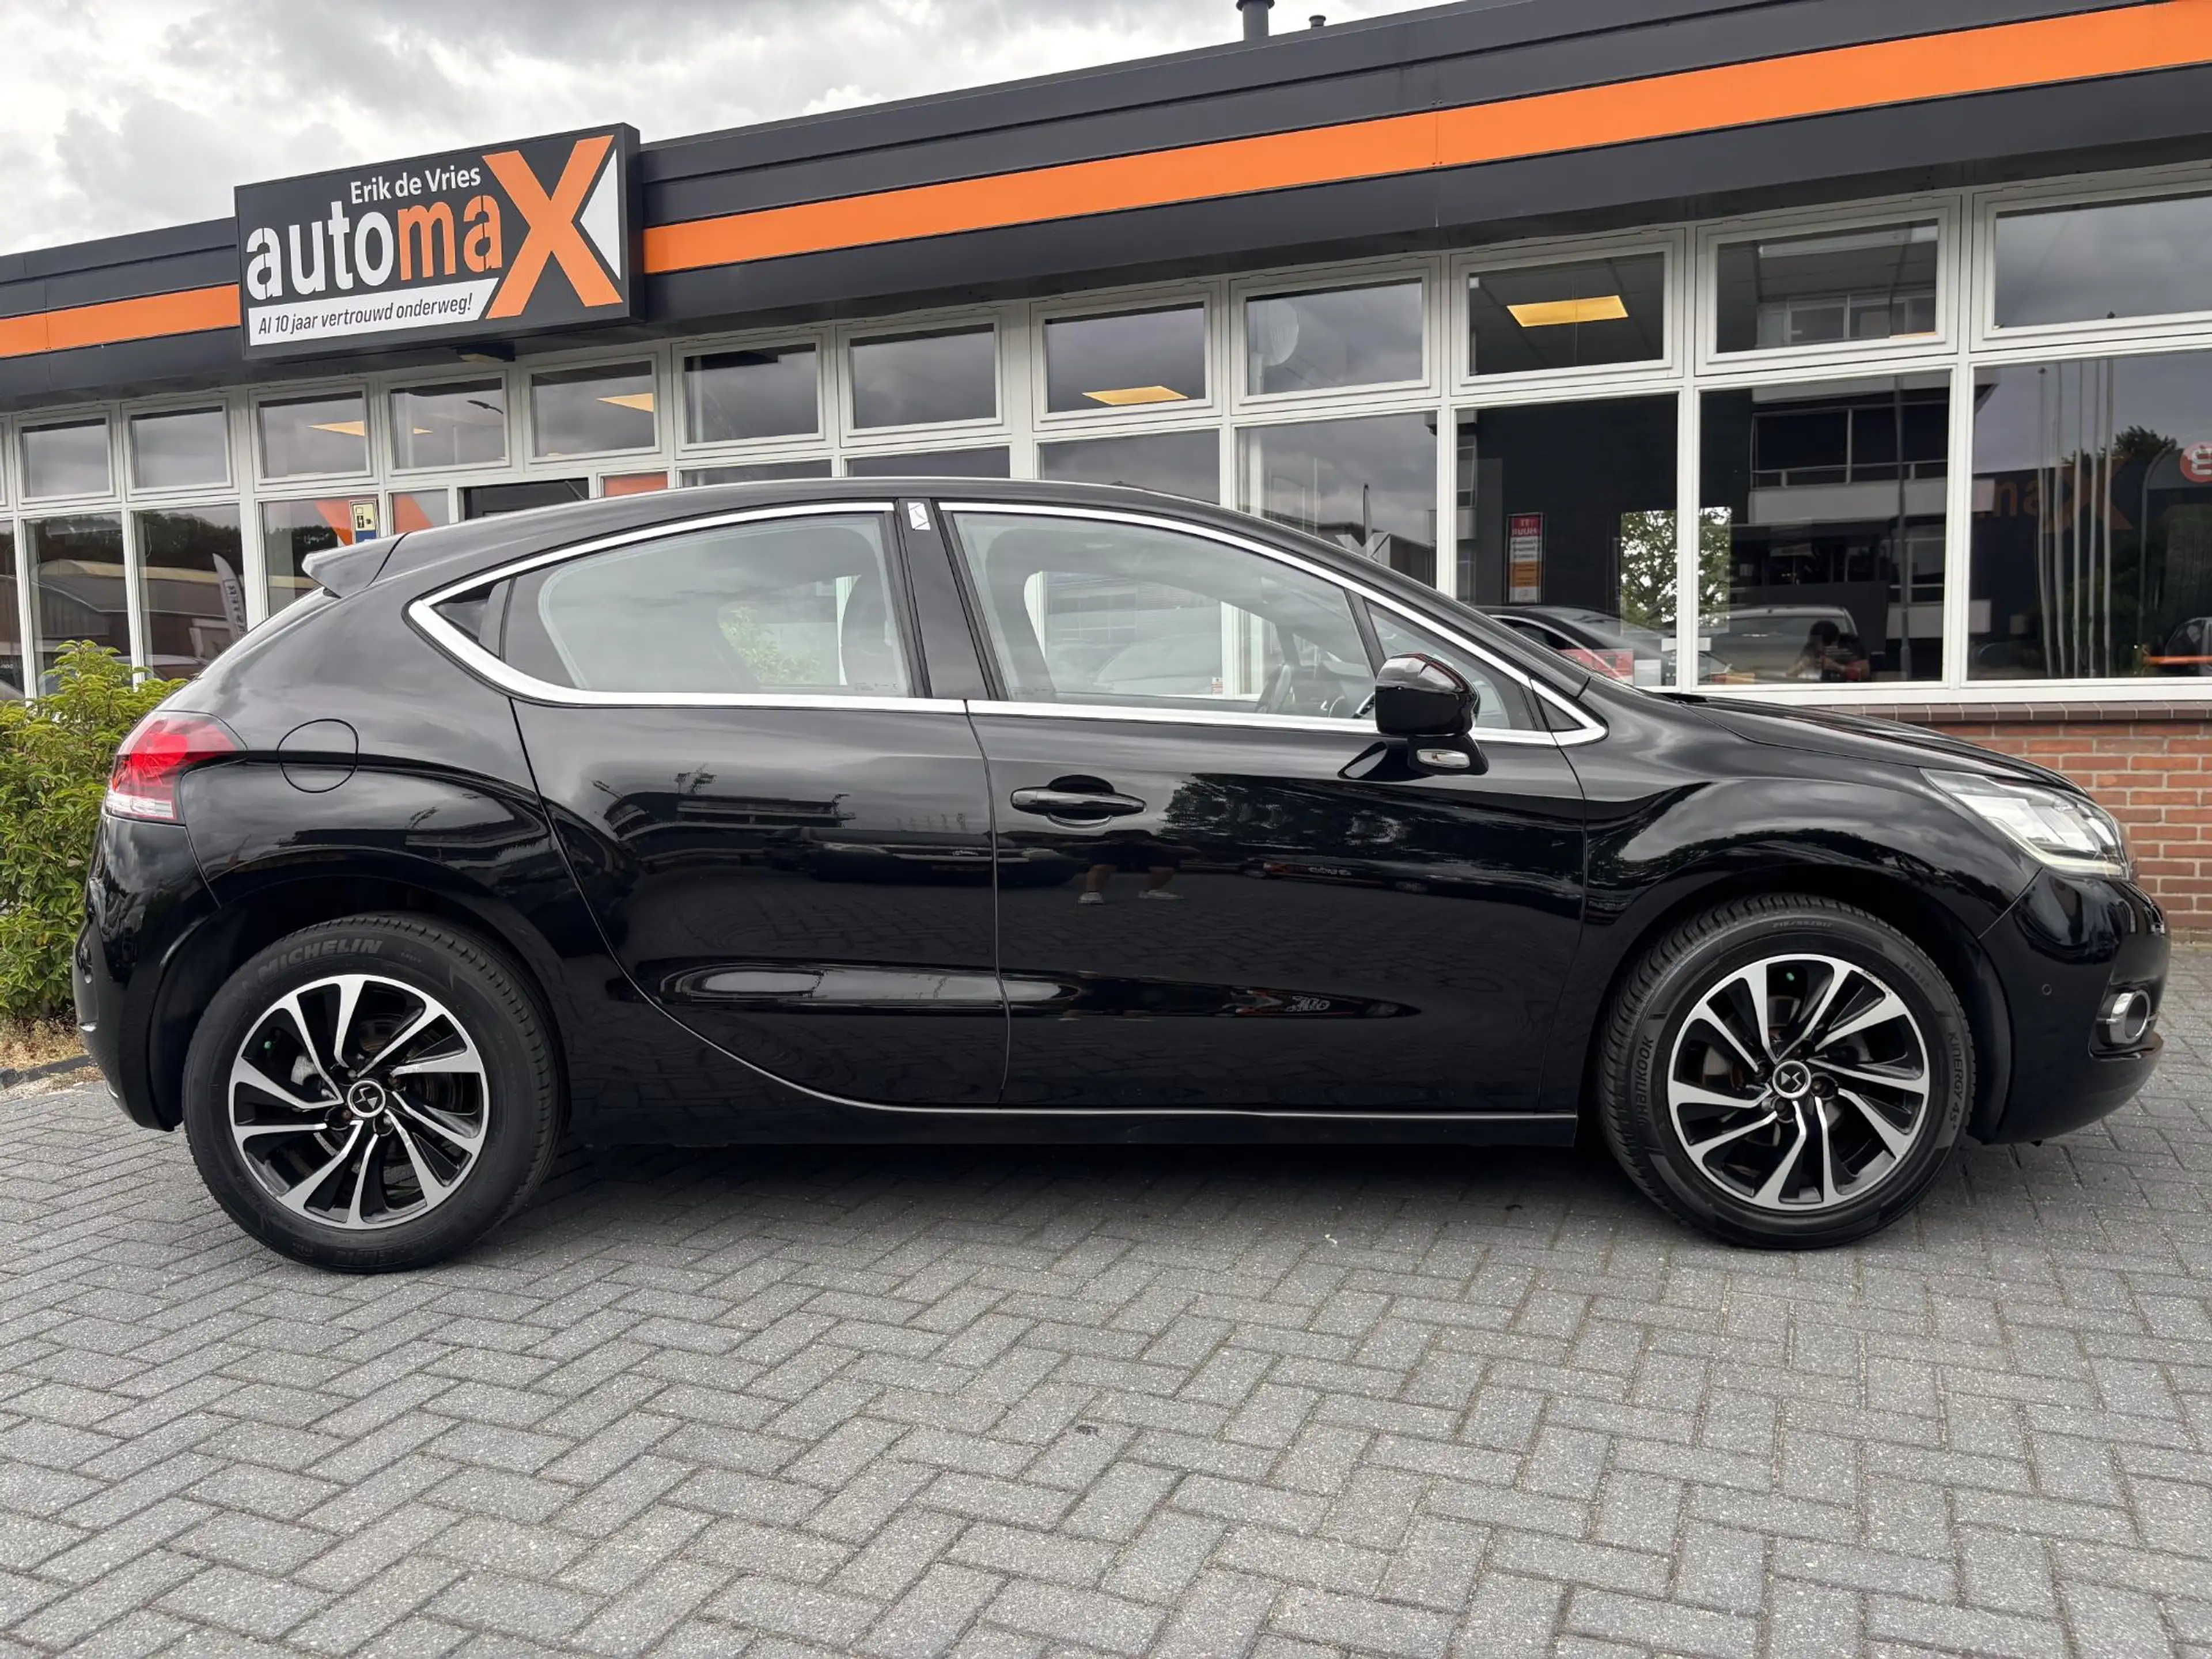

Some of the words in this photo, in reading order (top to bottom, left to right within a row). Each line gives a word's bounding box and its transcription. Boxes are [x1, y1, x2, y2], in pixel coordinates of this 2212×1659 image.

[350, 176, 392, 204] Erik
[395, 172, 422, 198] de
[425, 165, 481, 192] Vries
[259, 317, 272, 334] Al
[275, 315, 289, 333] 10
[289, 315, 317, 335] jaar
[321, 302, 394, 328] vertrouwd
[396, 292, 473, 319] onderweg!
[257, 938, 384, 978] MICHELIN
